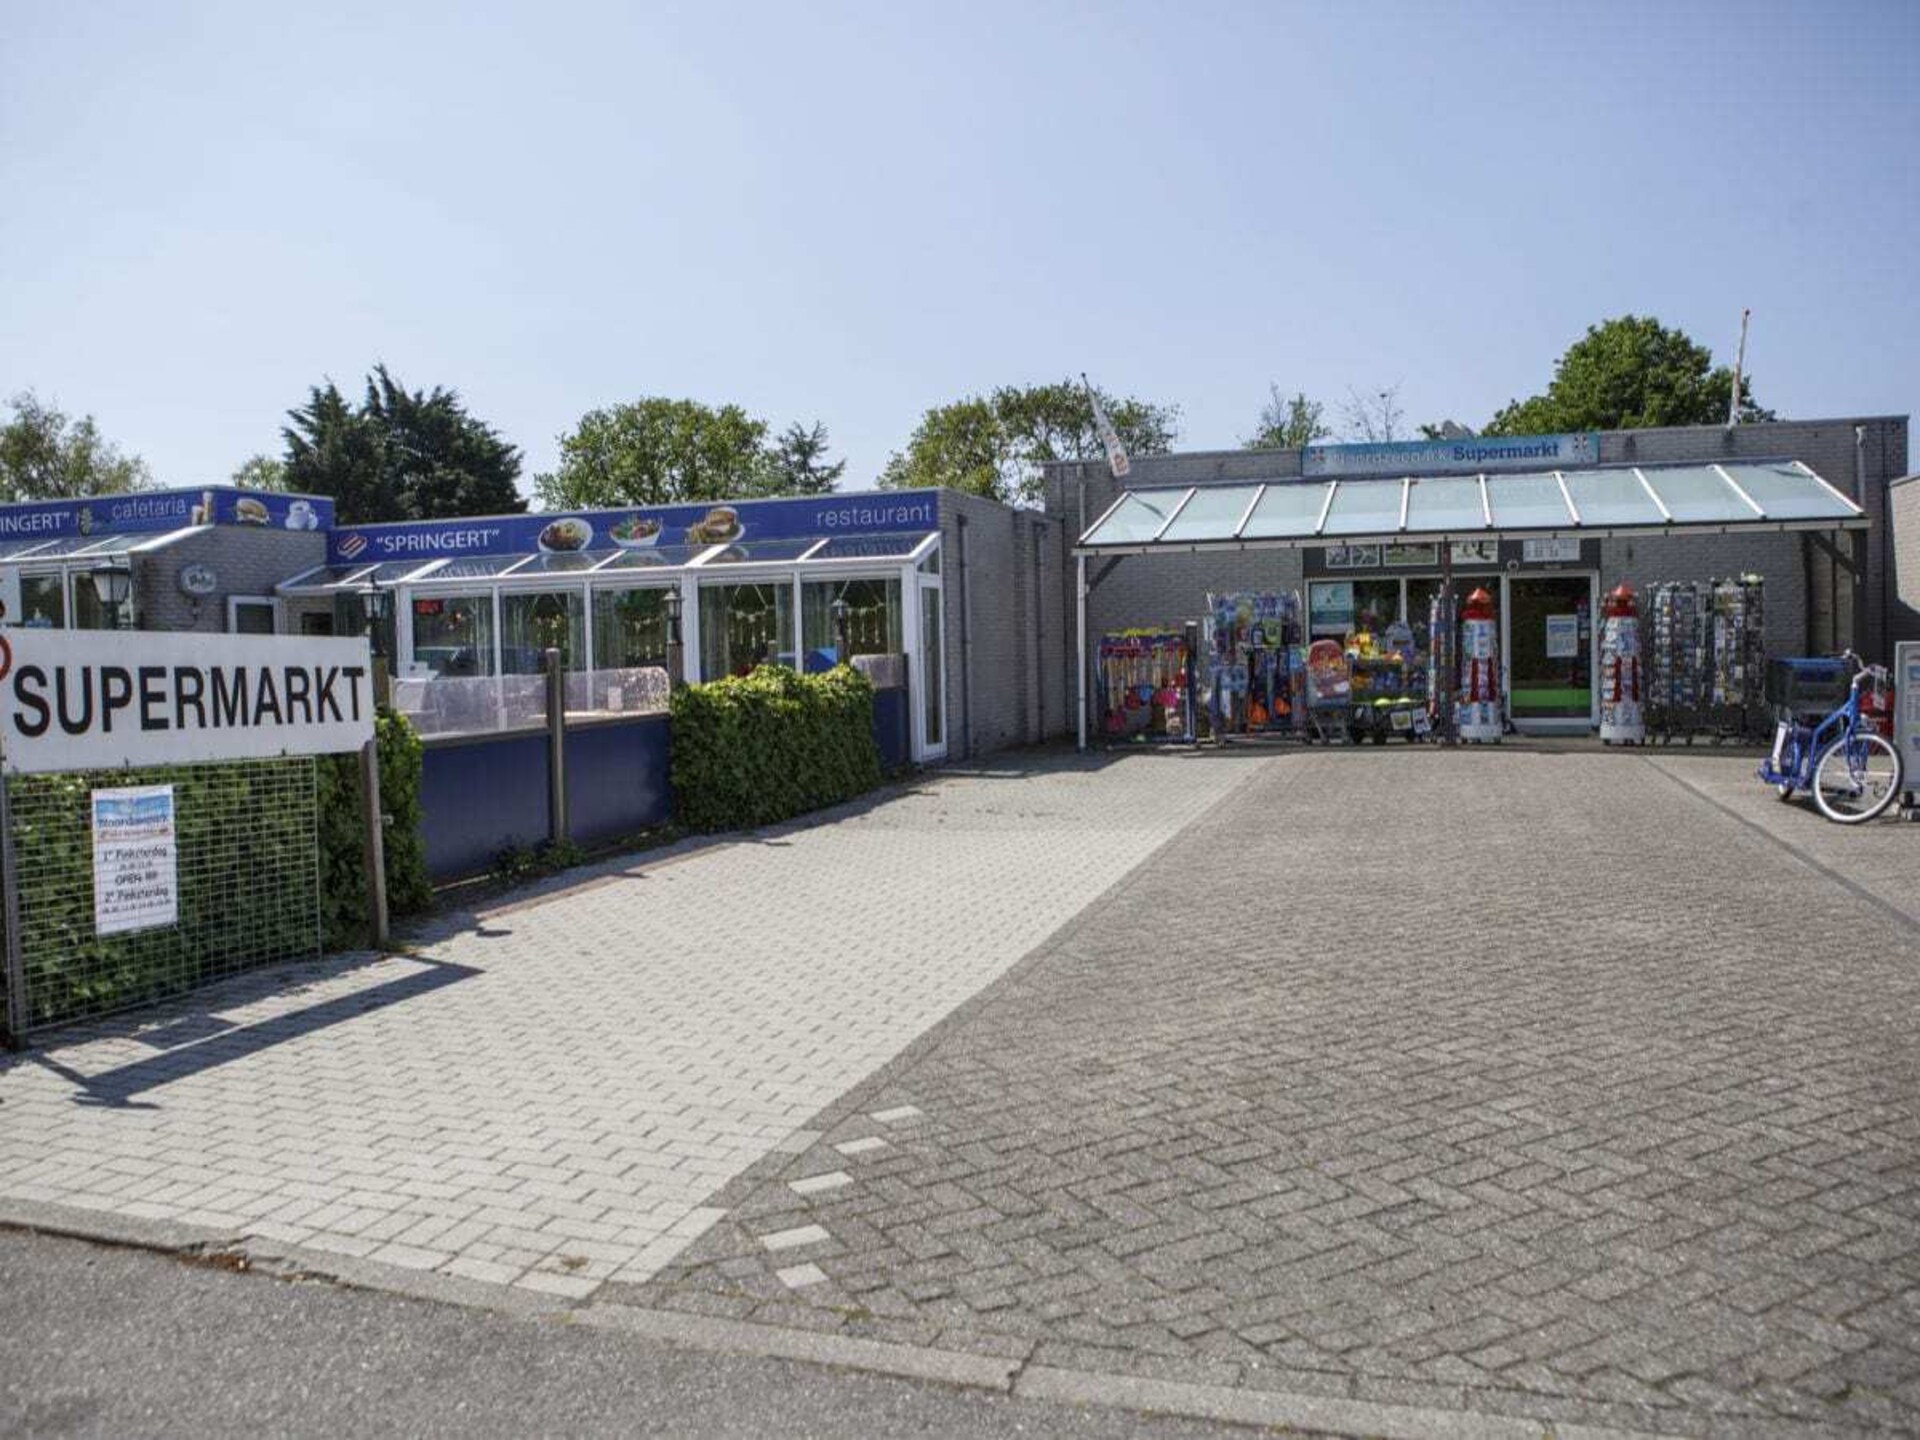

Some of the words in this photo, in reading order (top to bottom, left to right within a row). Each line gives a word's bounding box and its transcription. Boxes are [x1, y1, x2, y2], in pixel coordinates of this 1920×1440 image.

[1454, 441, 1559, 464] Supermarkt
[112, 498, 187, 519] cafetaria
[816, 502, 932, 526] restaurant
[13, 665, 365, 738] SUPERMARKT
